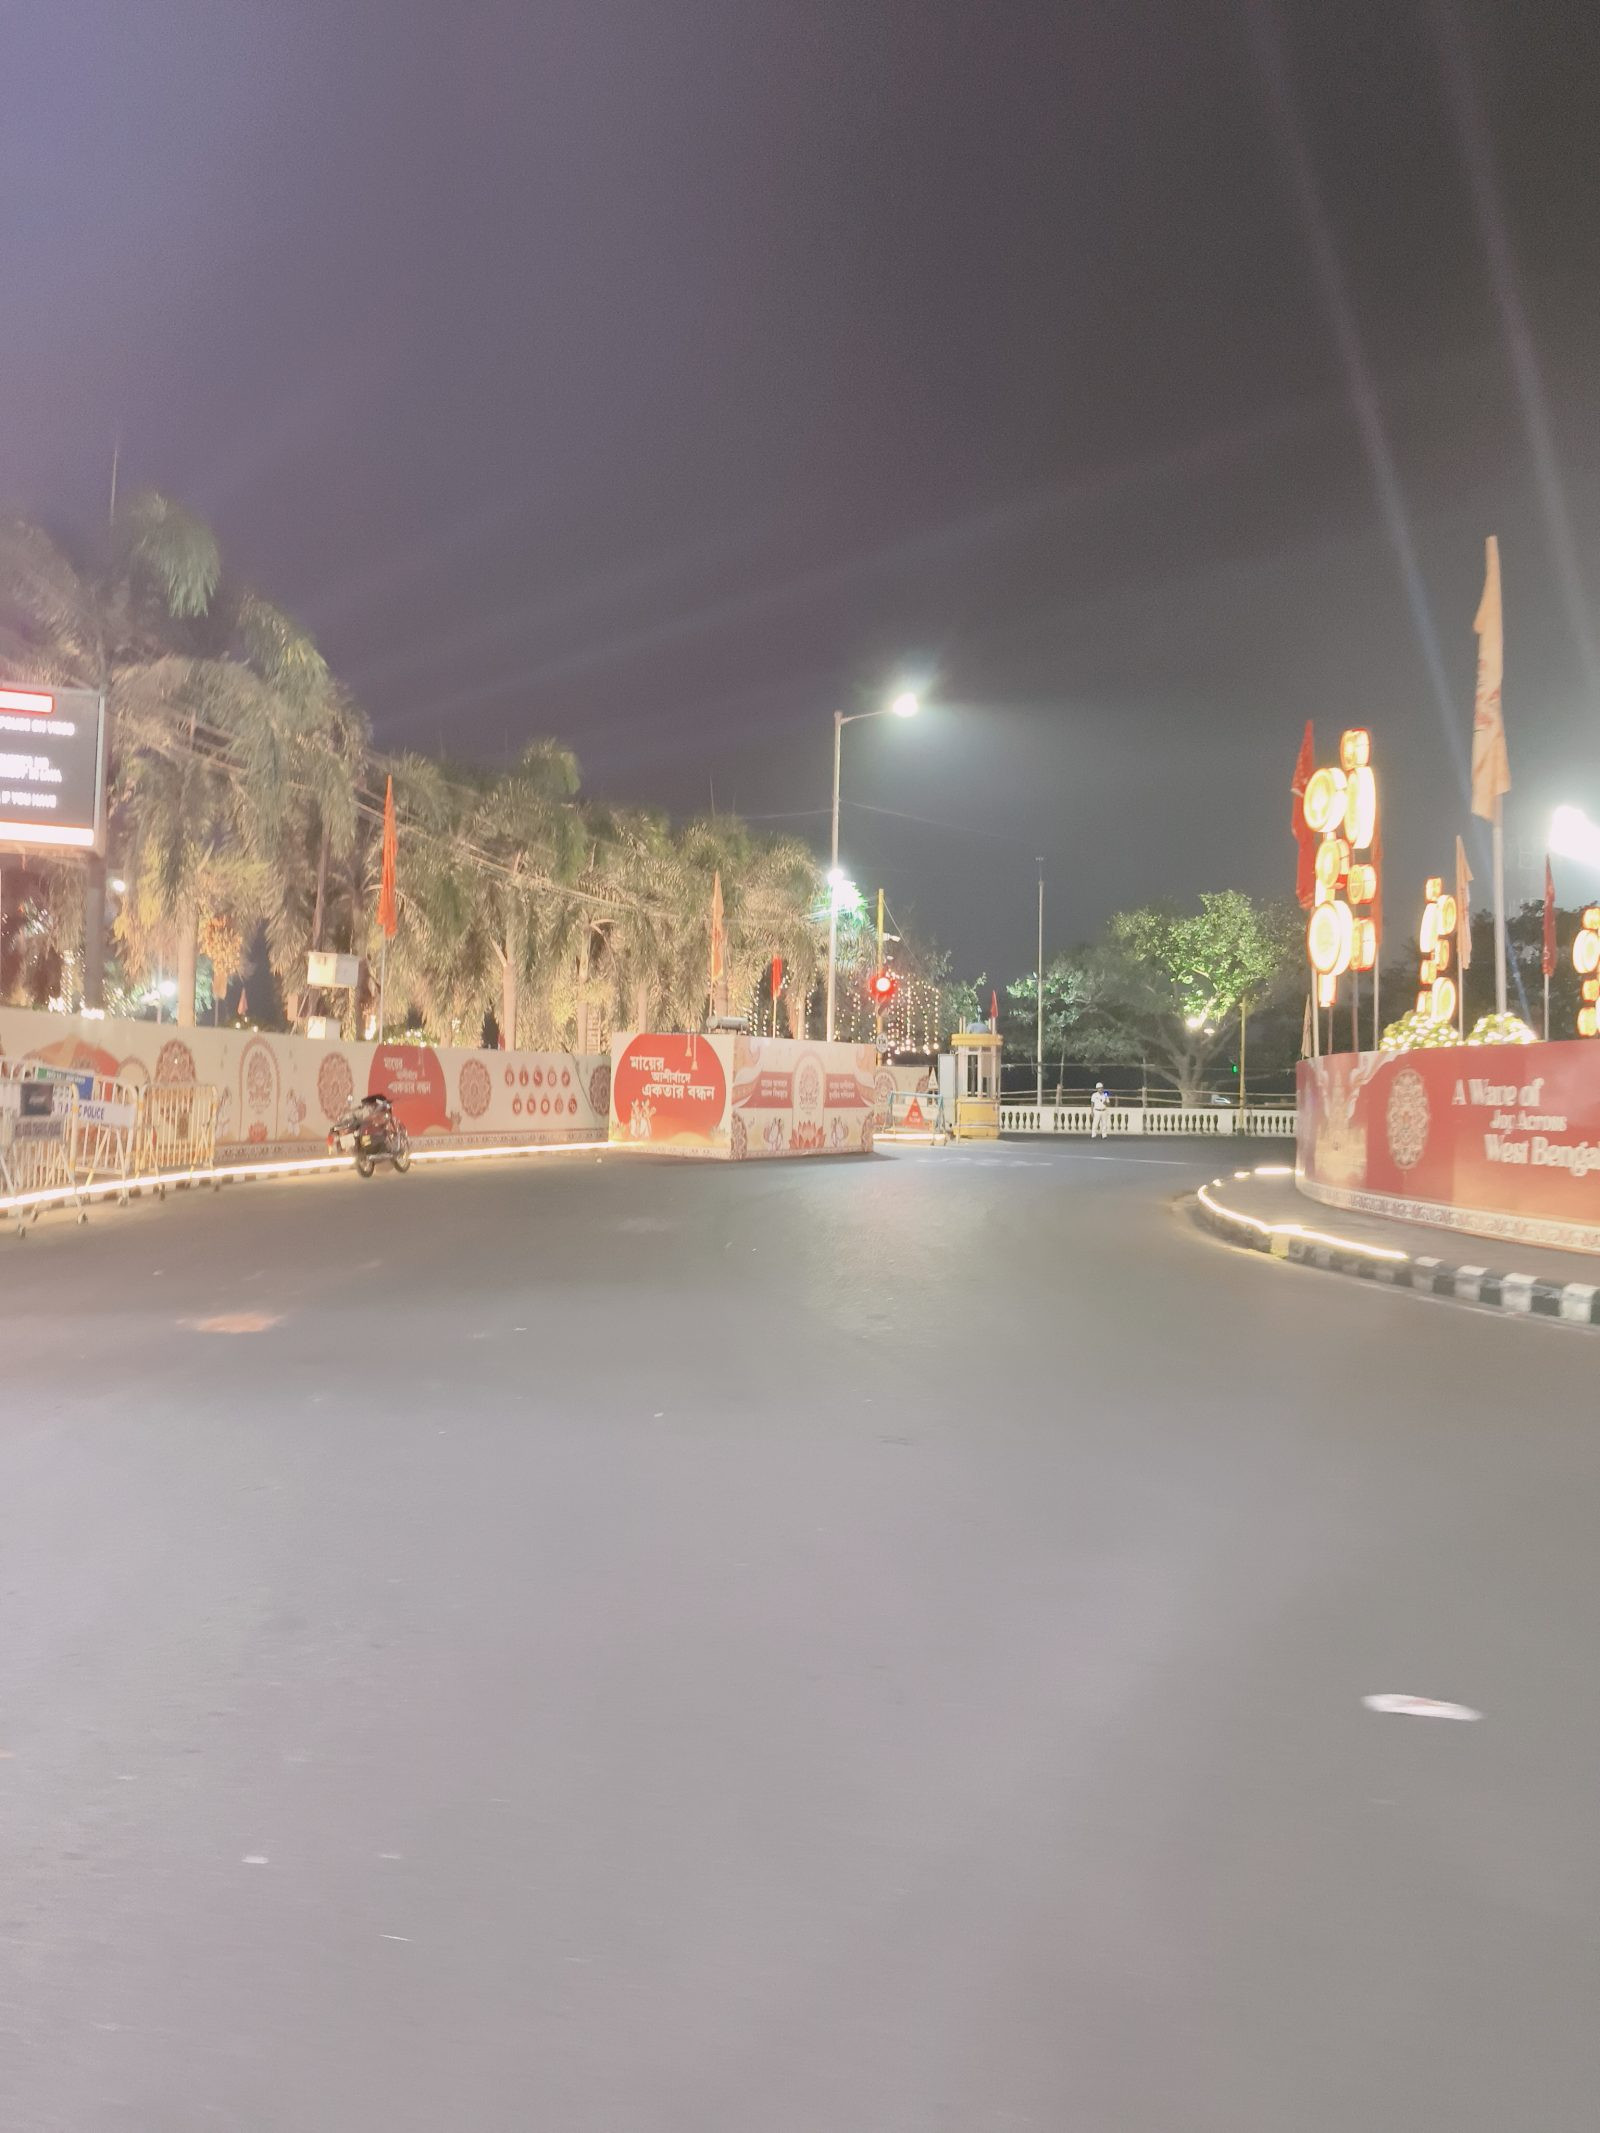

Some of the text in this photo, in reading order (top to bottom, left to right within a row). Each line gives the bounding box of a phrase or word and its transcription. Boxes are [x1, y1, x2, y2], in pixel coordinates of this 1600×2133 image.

[630, 1055, 664, 1071] মায়ের
[642, 1083, 715, 1101] একতার বন্ধন
[1452, 1079, 1467, 1106] A
[1519, 1077, 1545, 1107] of
[82, 1105, 104, 1120] POLICE
[1490, 1109, 1568, 1134] Joy Across
[1484, 1133, 1529, 1164] West
